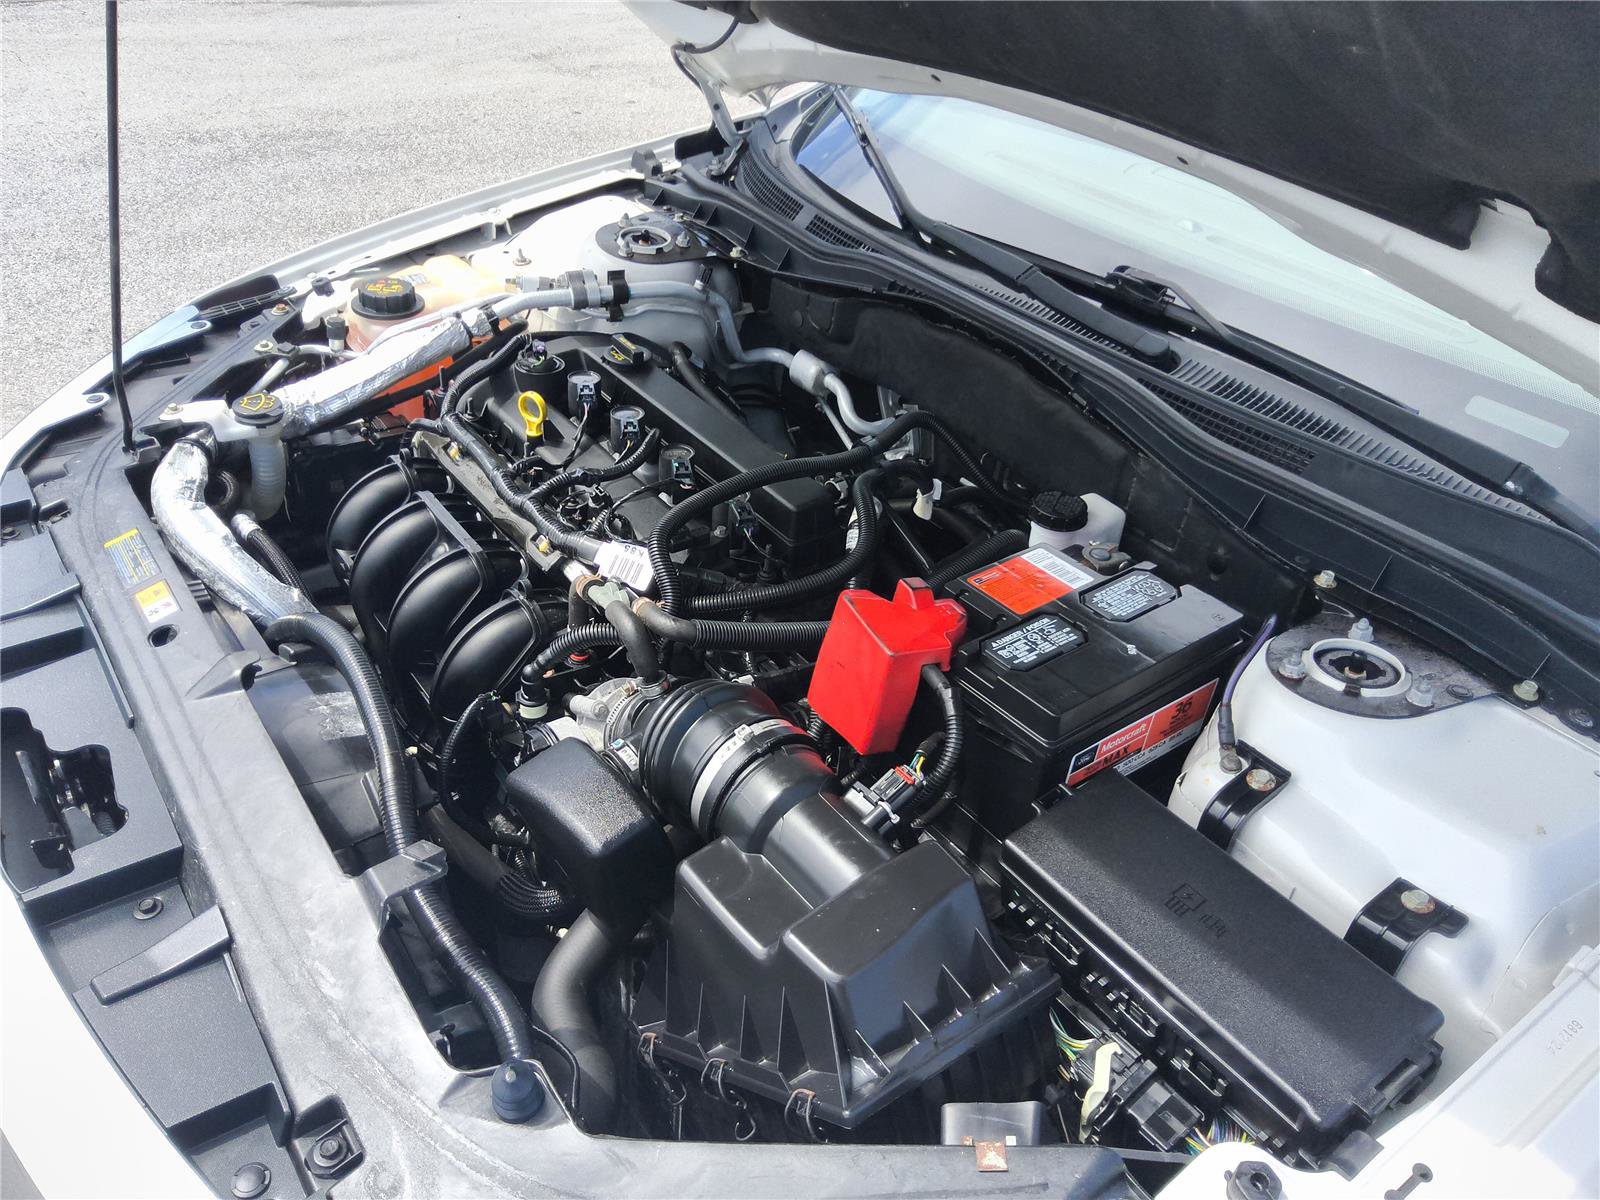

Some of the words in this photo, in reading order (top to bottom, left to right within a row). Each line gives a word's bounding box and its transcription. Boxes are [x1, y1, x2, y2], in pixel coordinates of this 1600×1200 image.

[996, 629, 1023, 645] DANGER
[1026, 617, 1051, 631] POISON
[1171, 696, 1193, 719] 36
[1100, 722, 1147, 754] Motorcraft
[1103, 745, 1131, 767] MAX
